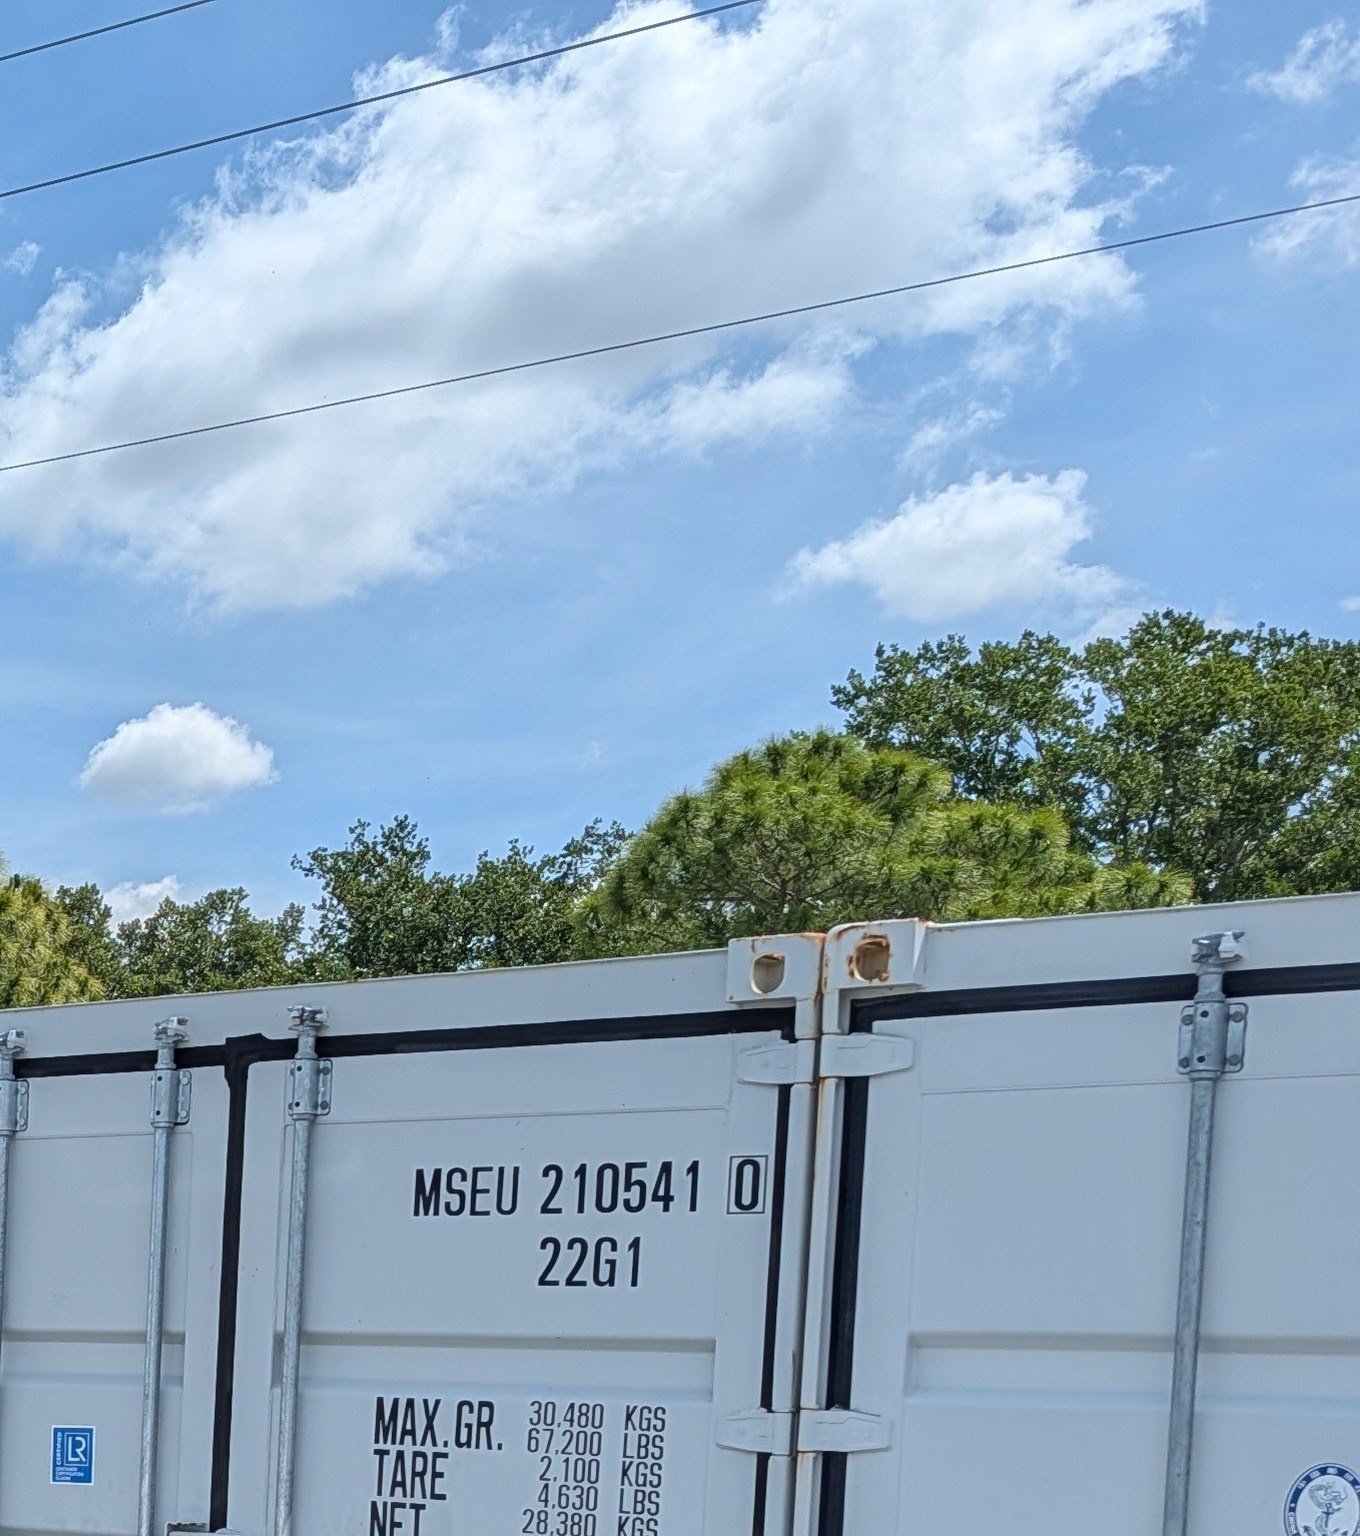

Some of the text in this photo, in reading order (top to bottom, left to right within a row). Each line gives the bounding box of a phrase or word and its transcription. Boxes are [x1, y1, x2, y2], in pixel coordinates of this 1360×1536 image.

[413, 1158, 761, 1217] MSEU 210541 0
[537, 1236, 641, 1287] 22G1
[624, 1404, 666, 1433] KGS
[68, 1436, 86, 1462] LR
[622, 1432, 664, 1461] LBS
[374, 1448, 447, 1501] TARE
[620, 1460, 663, 1489] KGS
[618, 1487, 660, 1516] LBS
